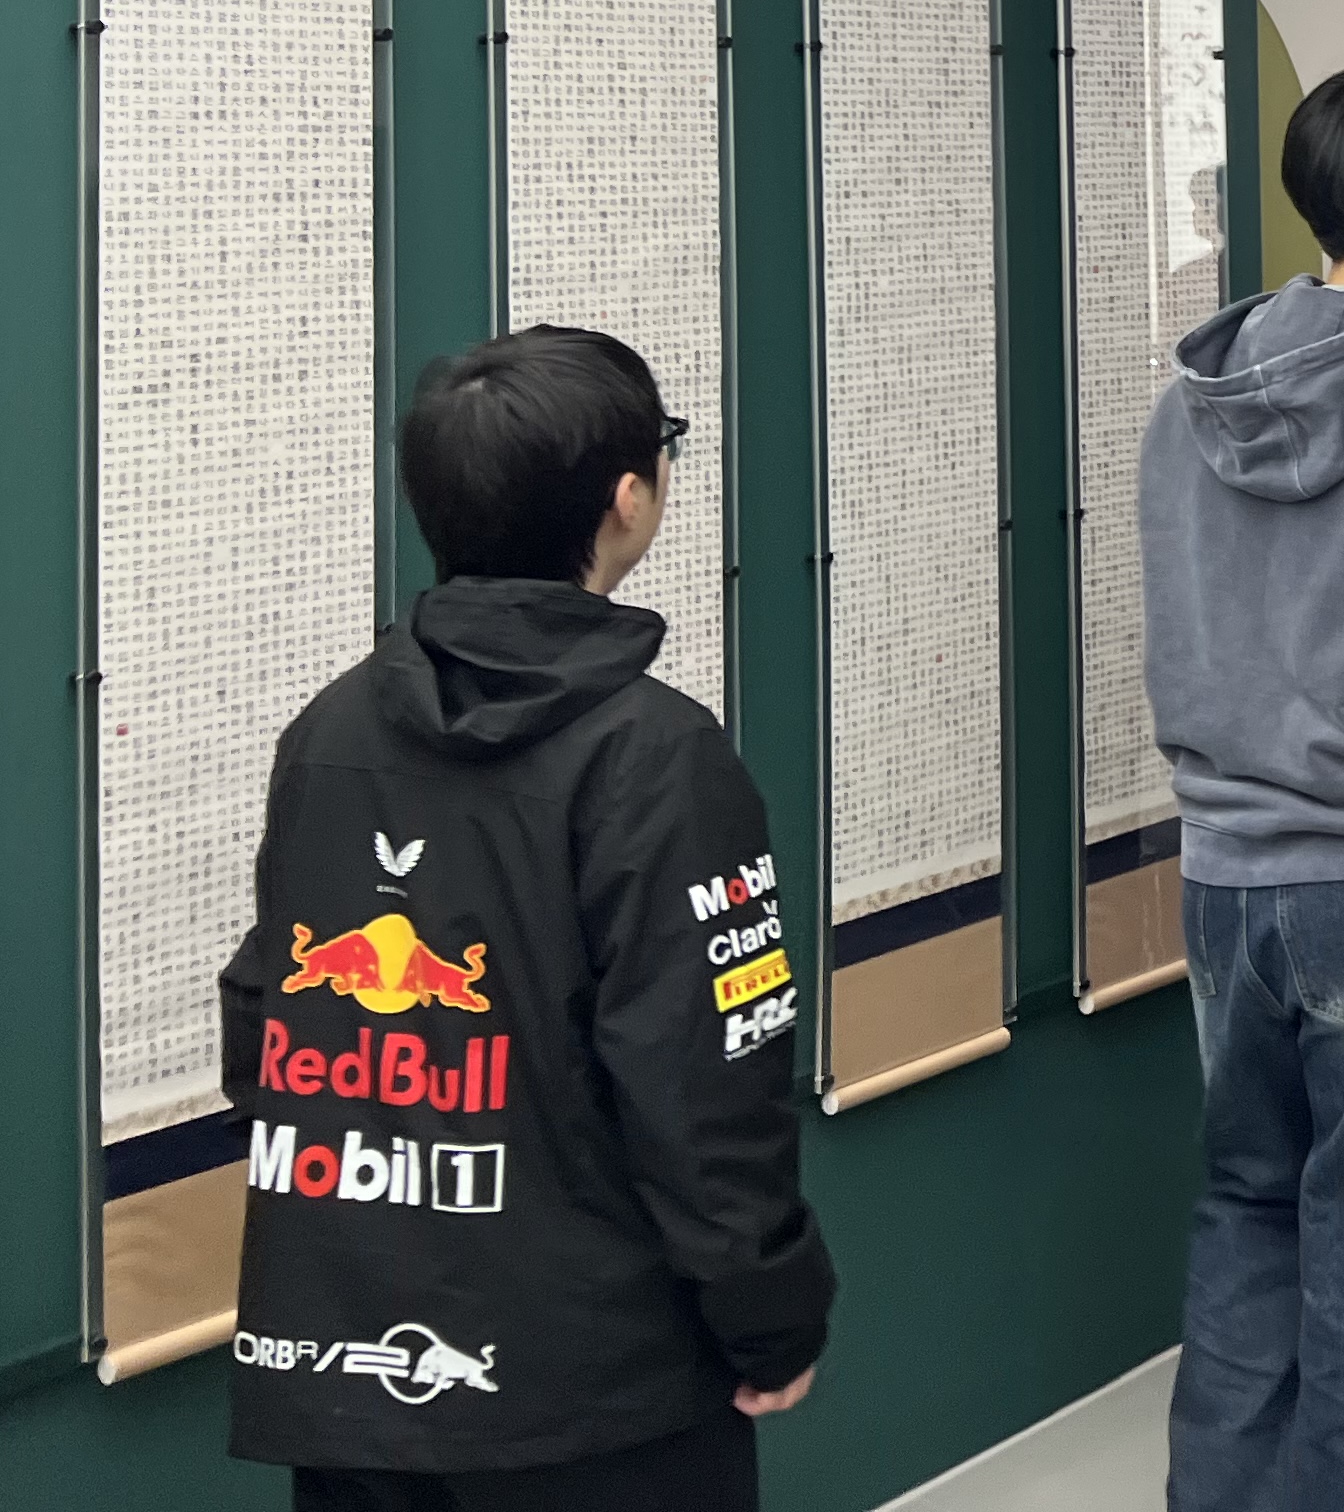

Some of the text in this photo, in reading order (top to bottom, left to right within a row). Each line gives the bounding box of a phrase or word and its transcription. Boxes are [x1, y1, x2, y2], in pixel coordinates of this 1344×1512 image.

[687, 853, 777, 922] Mobil
[707, 916, 782, 966] Claro
[248, 1118, 475, 1208] Mobil 1
